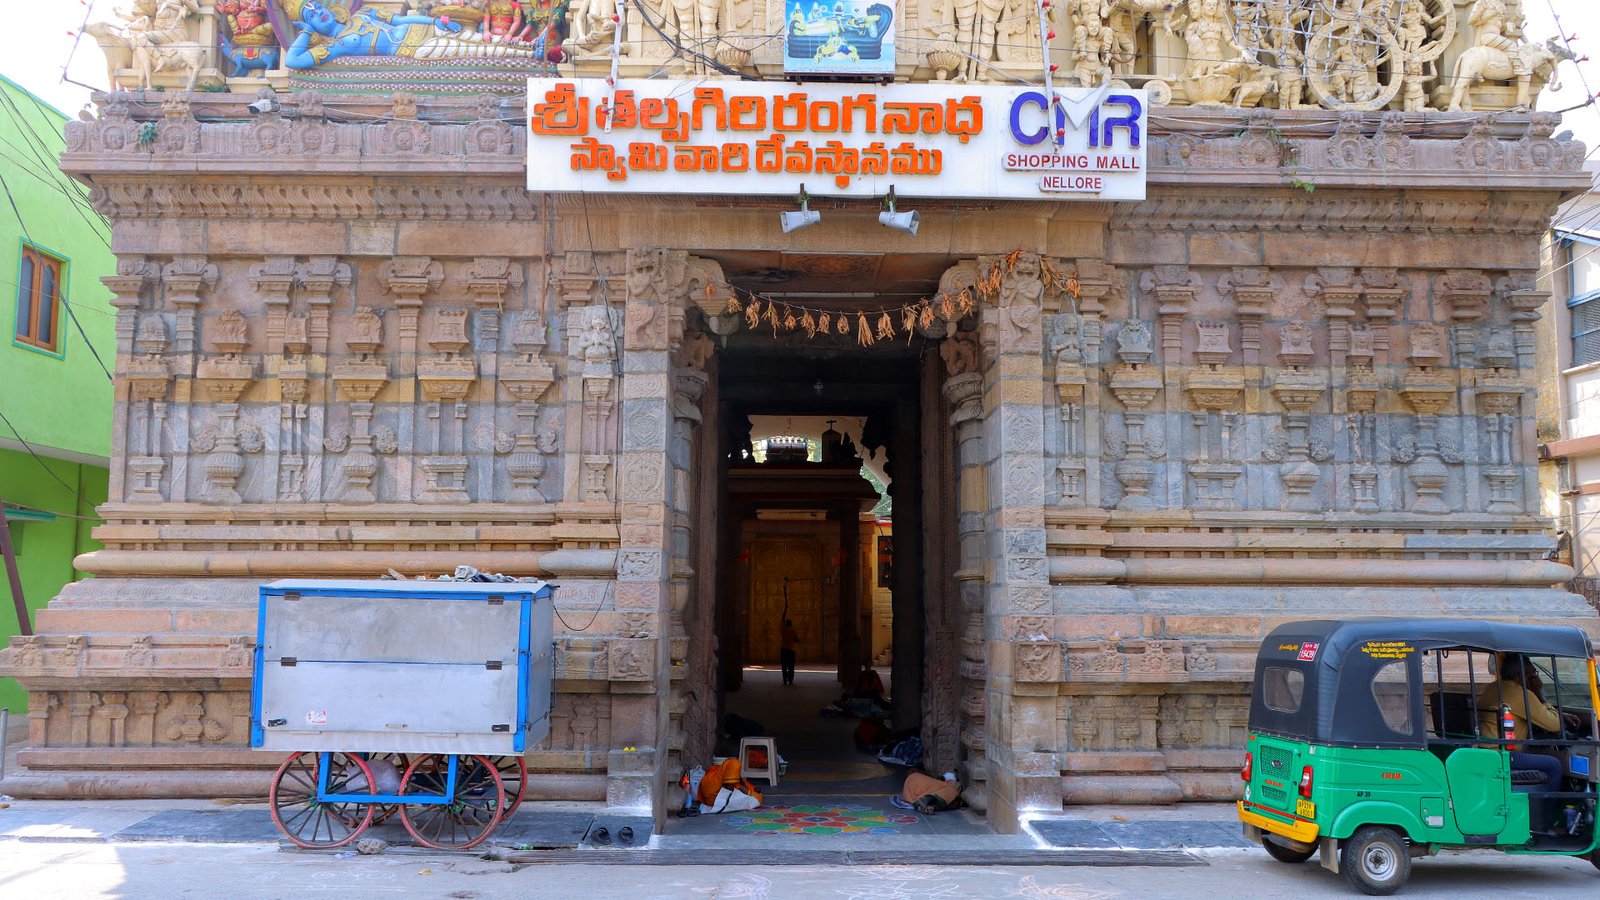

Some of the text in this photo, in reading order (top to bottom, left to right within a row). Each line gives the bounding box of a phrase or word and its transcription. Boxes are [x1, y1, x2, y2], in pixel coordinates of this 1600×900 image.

[531, 83, 589, 136] శ్రీ
[1010, 83, 1142, 149] CMR
[1007, 154, 1140, 169] SHOPPING MALL
[1043, 176, 1102, 189] NELLORE
